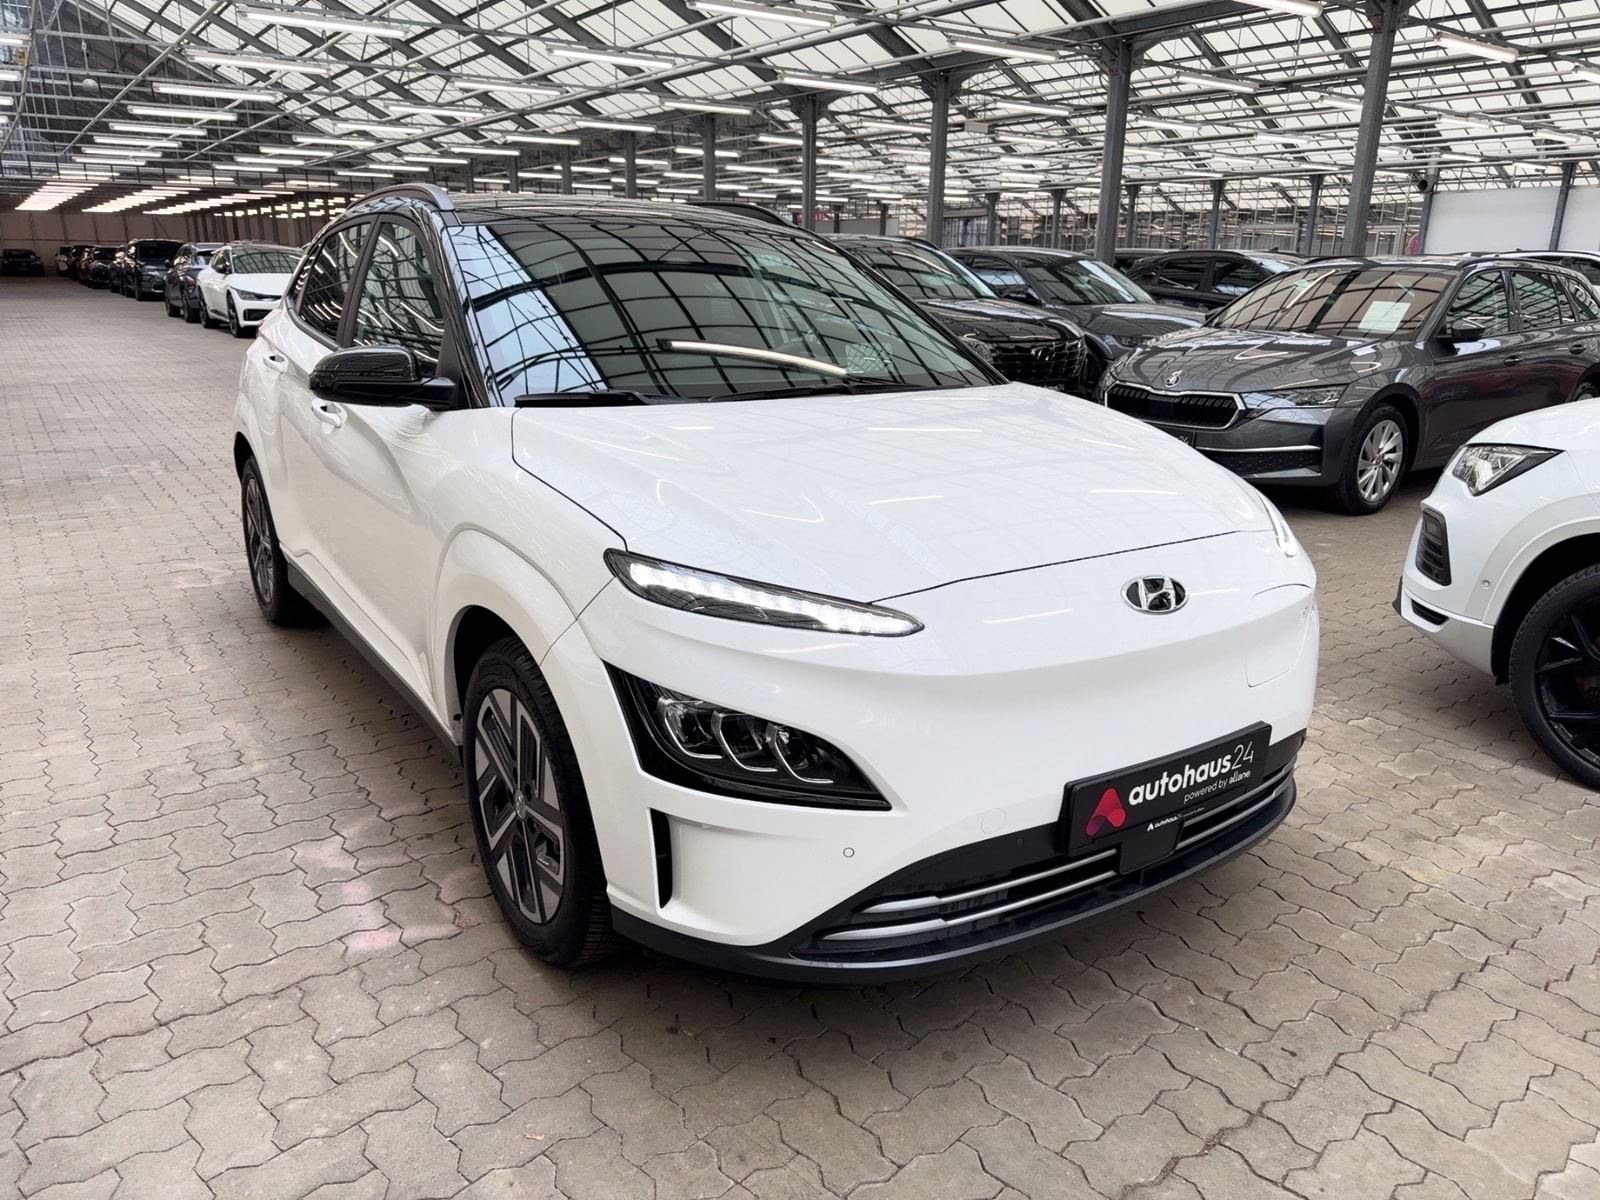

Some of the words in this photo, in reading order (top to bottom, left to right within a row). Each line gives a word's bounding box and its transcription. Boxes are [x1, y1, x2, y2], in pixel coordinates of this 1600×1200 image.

[1128, 740, 1255, 806] autohaus24
[1183, 780, 1218, 804] powered
[1218, 777, 1229, 790] by
[1228, 769, 1252, 785] allane
